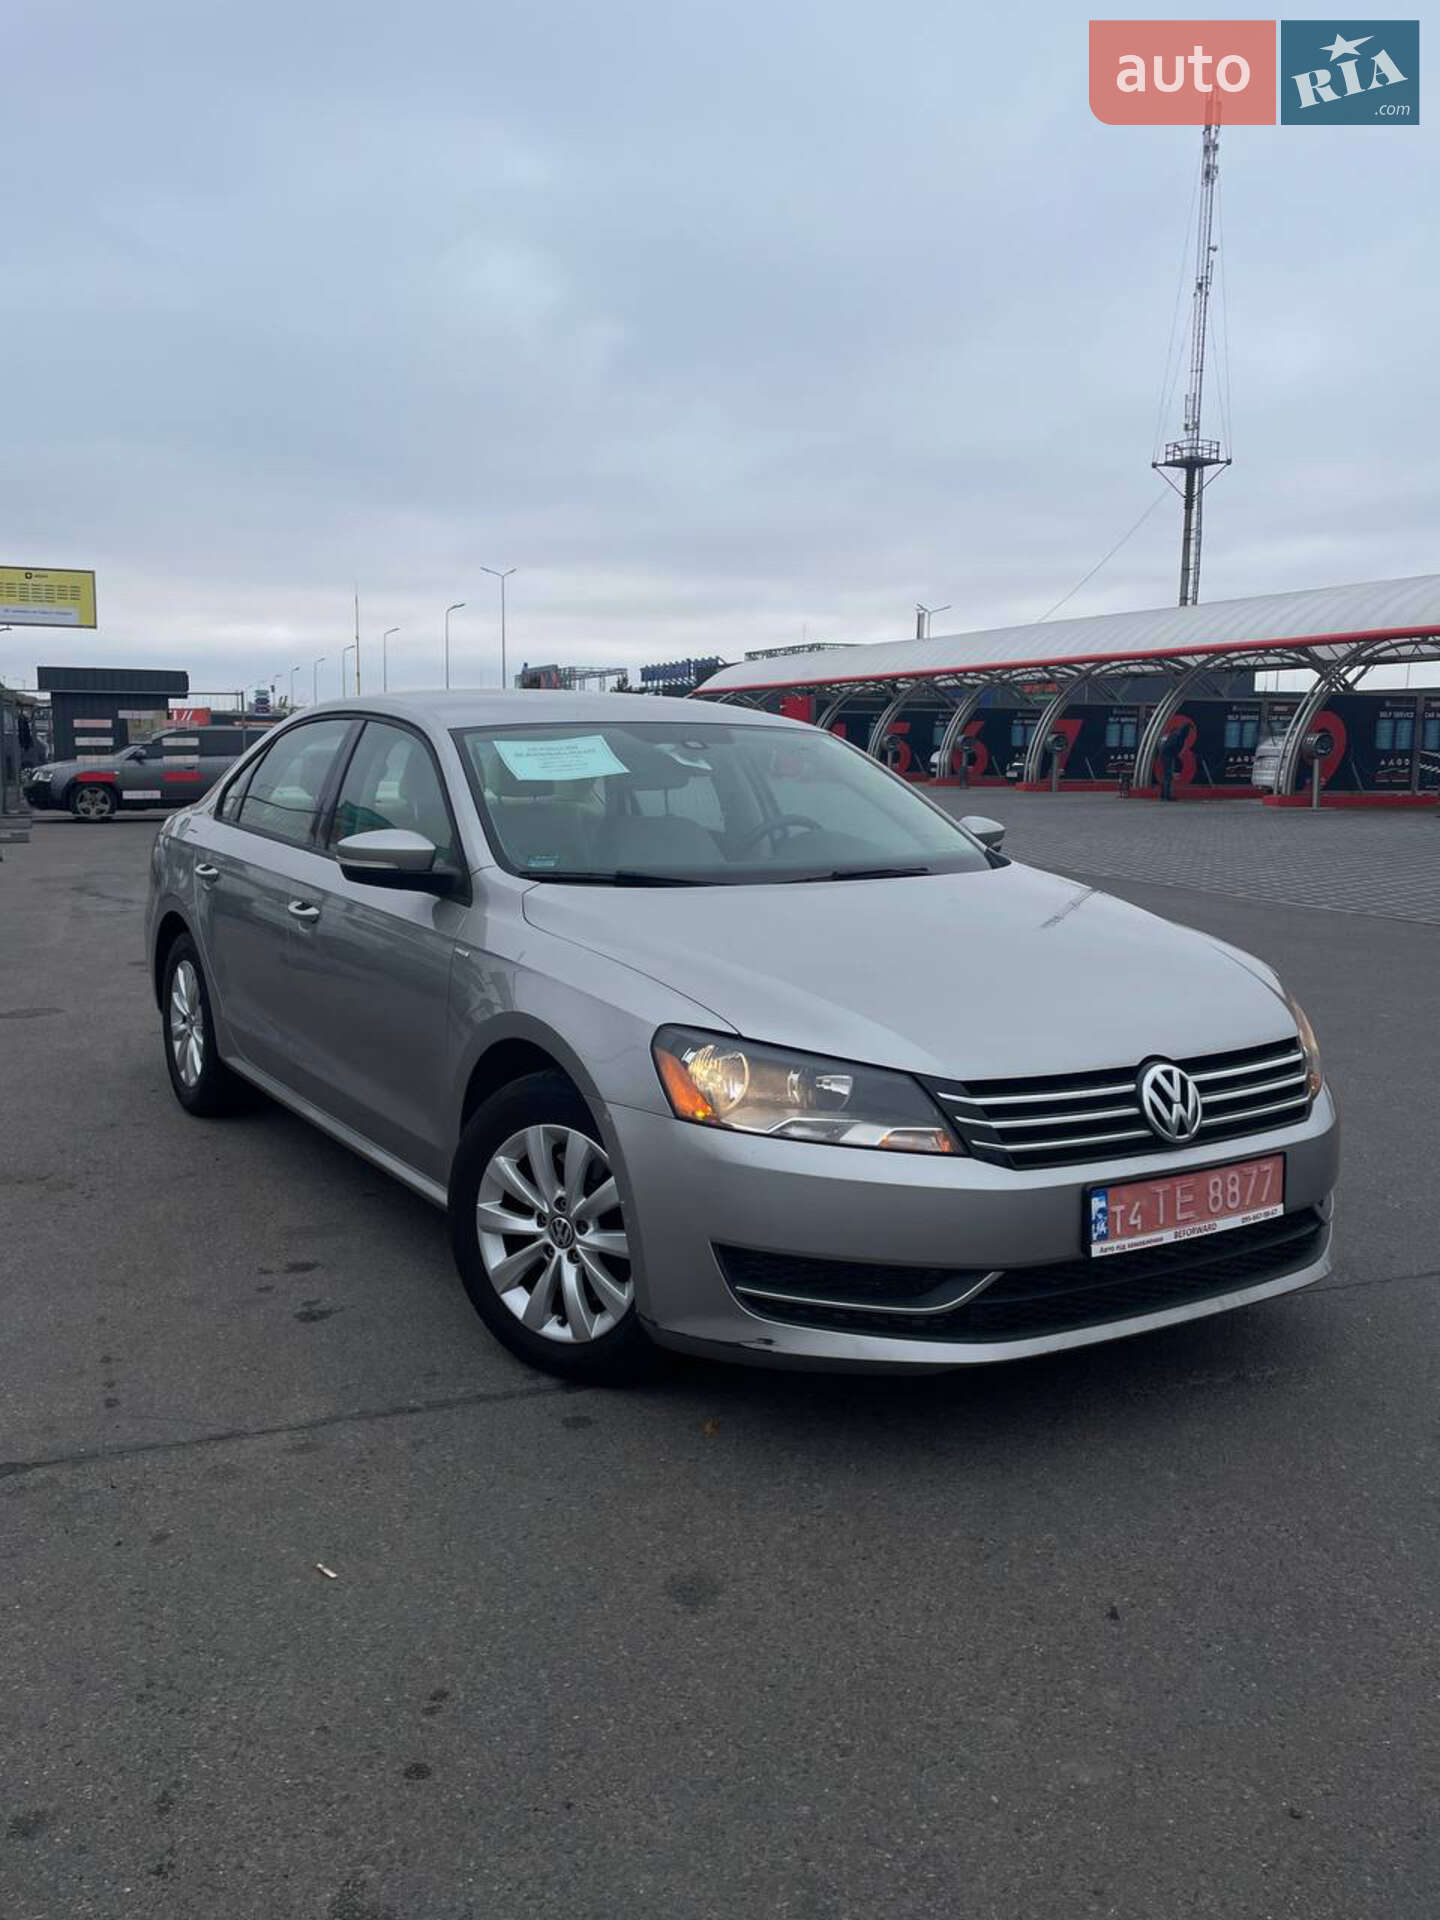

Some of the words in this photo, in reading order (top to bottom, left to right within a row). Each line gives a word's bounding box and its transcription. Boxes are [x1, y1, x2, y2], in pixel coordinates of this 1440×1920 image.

[953, 720, 989, 776] 6
[1051, 720, 1082, 771] 7
[1111, 1202, 1142, 1234] T4
[1152, 1179, 1198, 1225] TE
[1208, 1163, 1273, 1213] 8877
